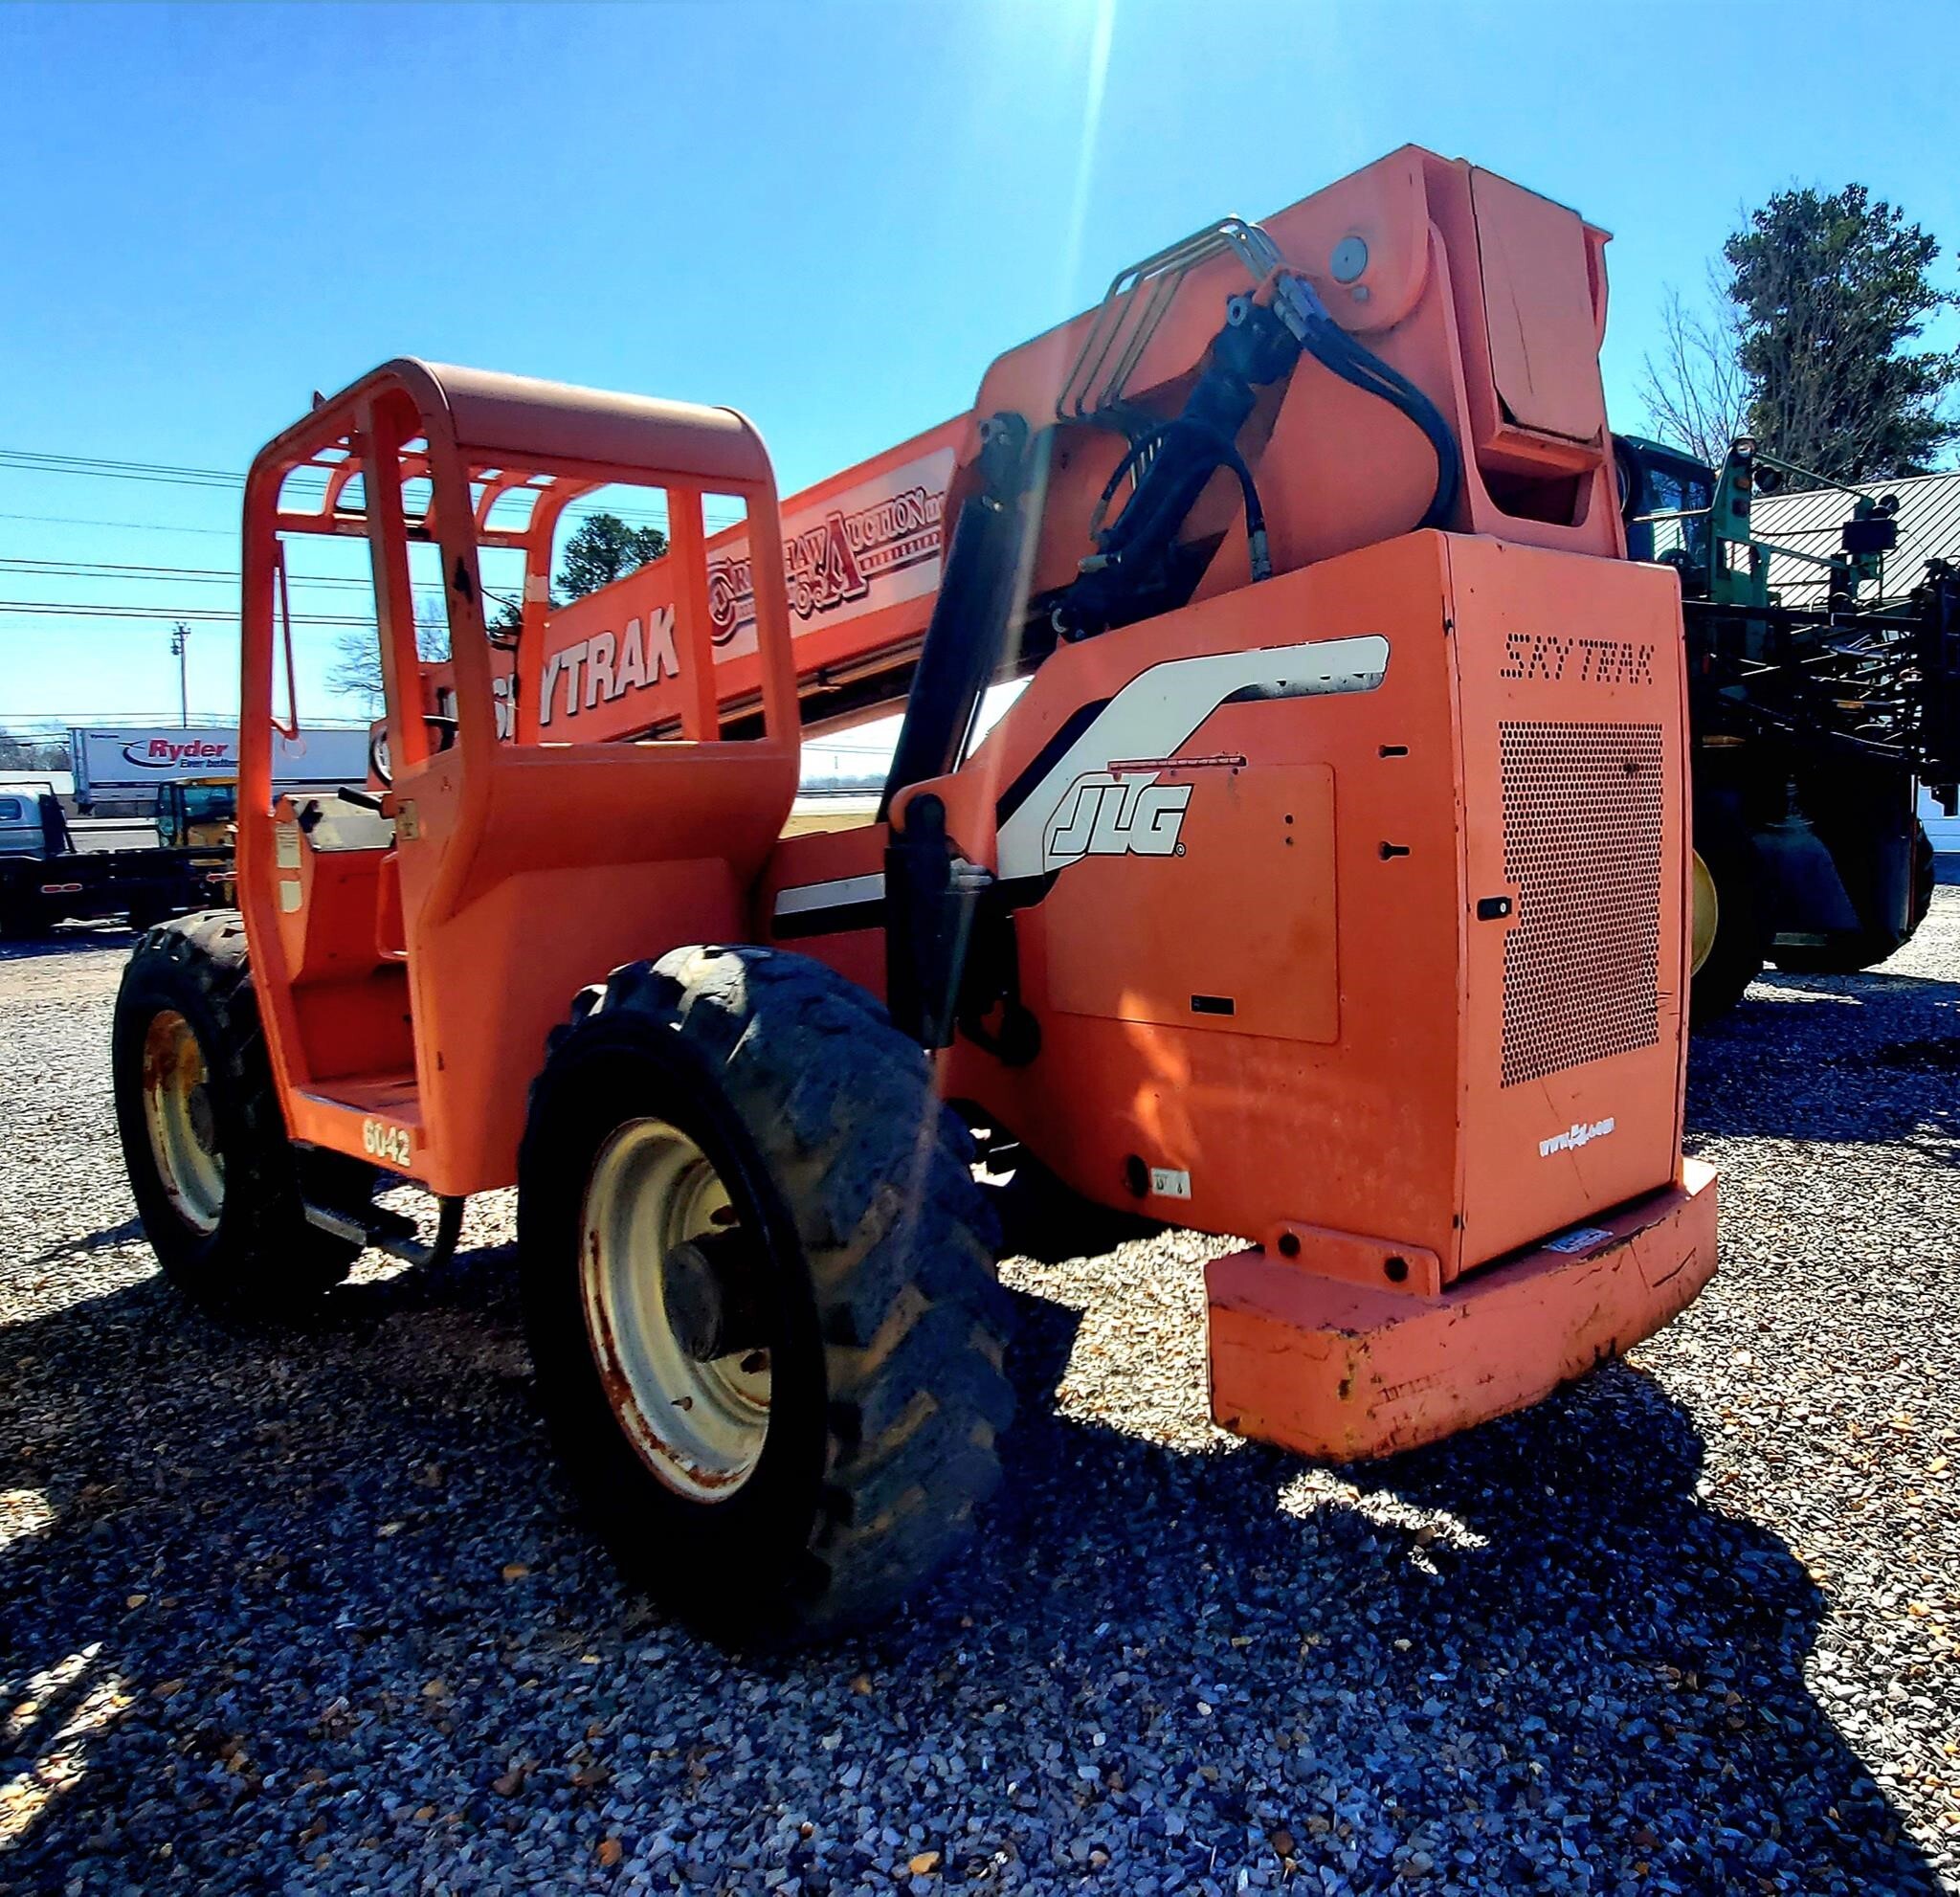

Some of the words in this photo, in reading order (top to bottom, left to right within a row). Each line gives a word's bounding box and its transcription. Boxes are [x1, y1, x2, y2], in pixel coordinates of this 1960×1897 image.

[824, 486, 926, 602] AUCTION
[148, 739, 229, 761] Ryder
[363, 1119, 411, 1167] 6042
